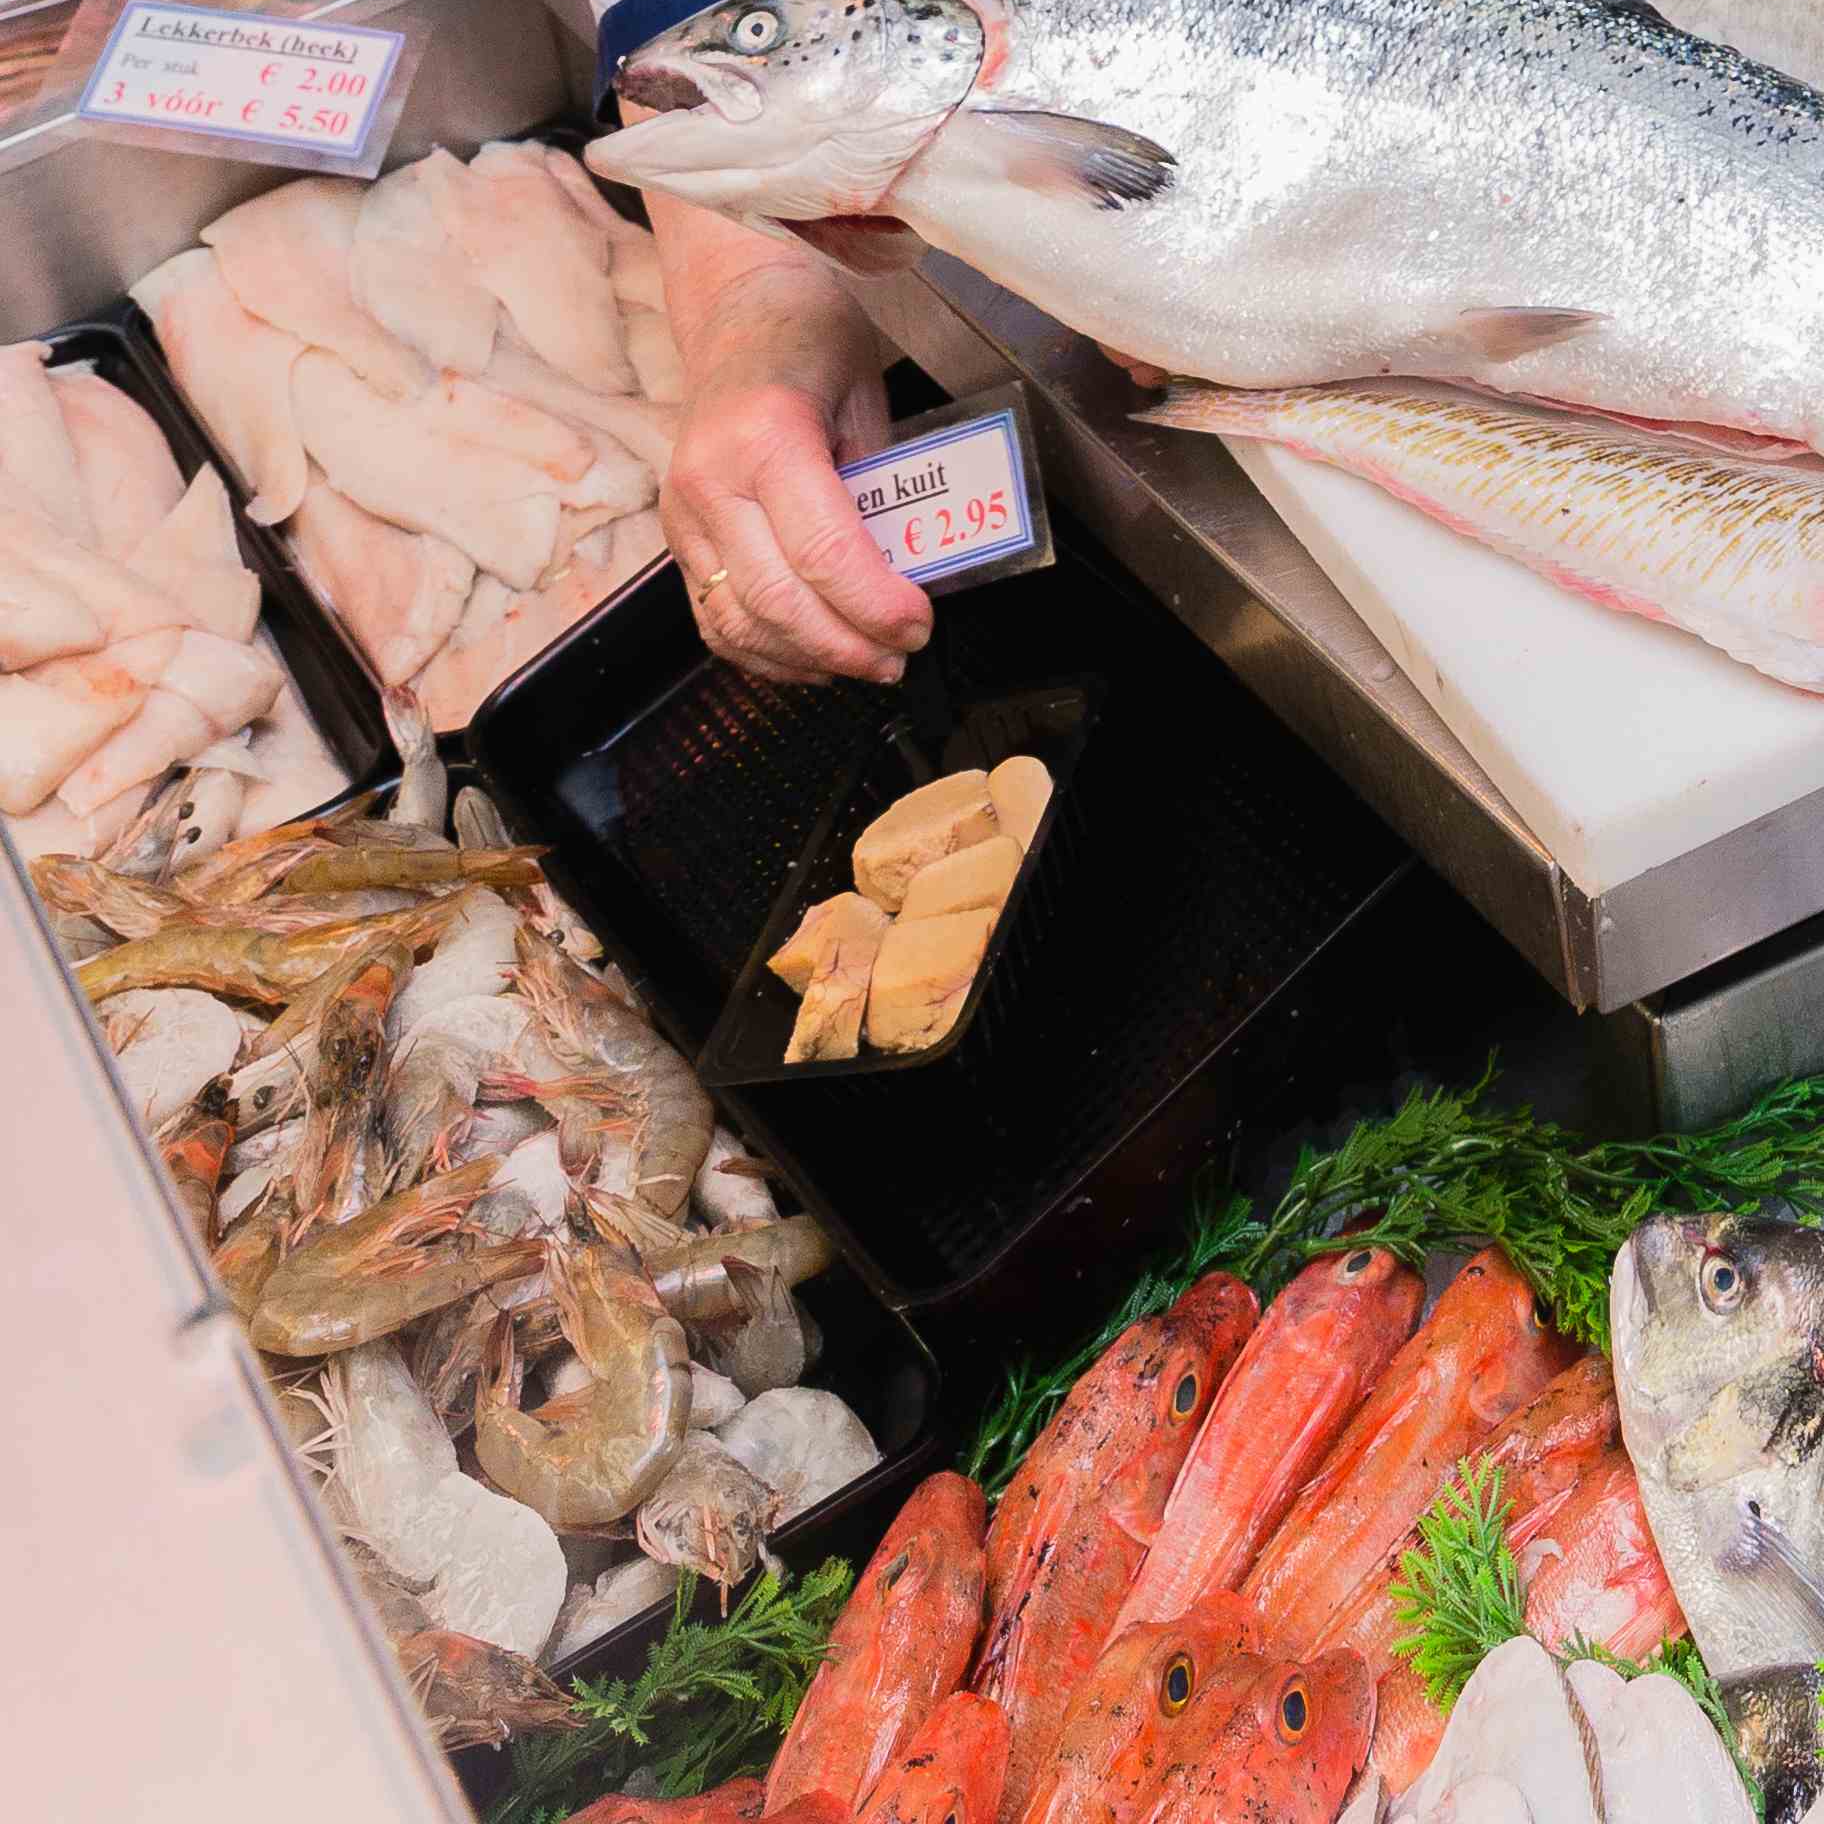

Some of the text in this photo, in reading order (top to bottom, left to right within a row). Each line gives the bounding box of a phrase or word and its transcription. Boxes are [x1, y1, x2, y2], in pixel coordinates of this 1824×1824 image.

[137, 13, 360, 64] Lekkerbek (heek)
[120, 52, 153, 72] Per
[259, 62, 283, 88] €
[296, 66, 369, 98] 2.00
[103, 80, 350, 137] 3 vóór € 5.50
[893, 461, 949, 502] kuit
[903, 489, 1009, 557] € 2.95
